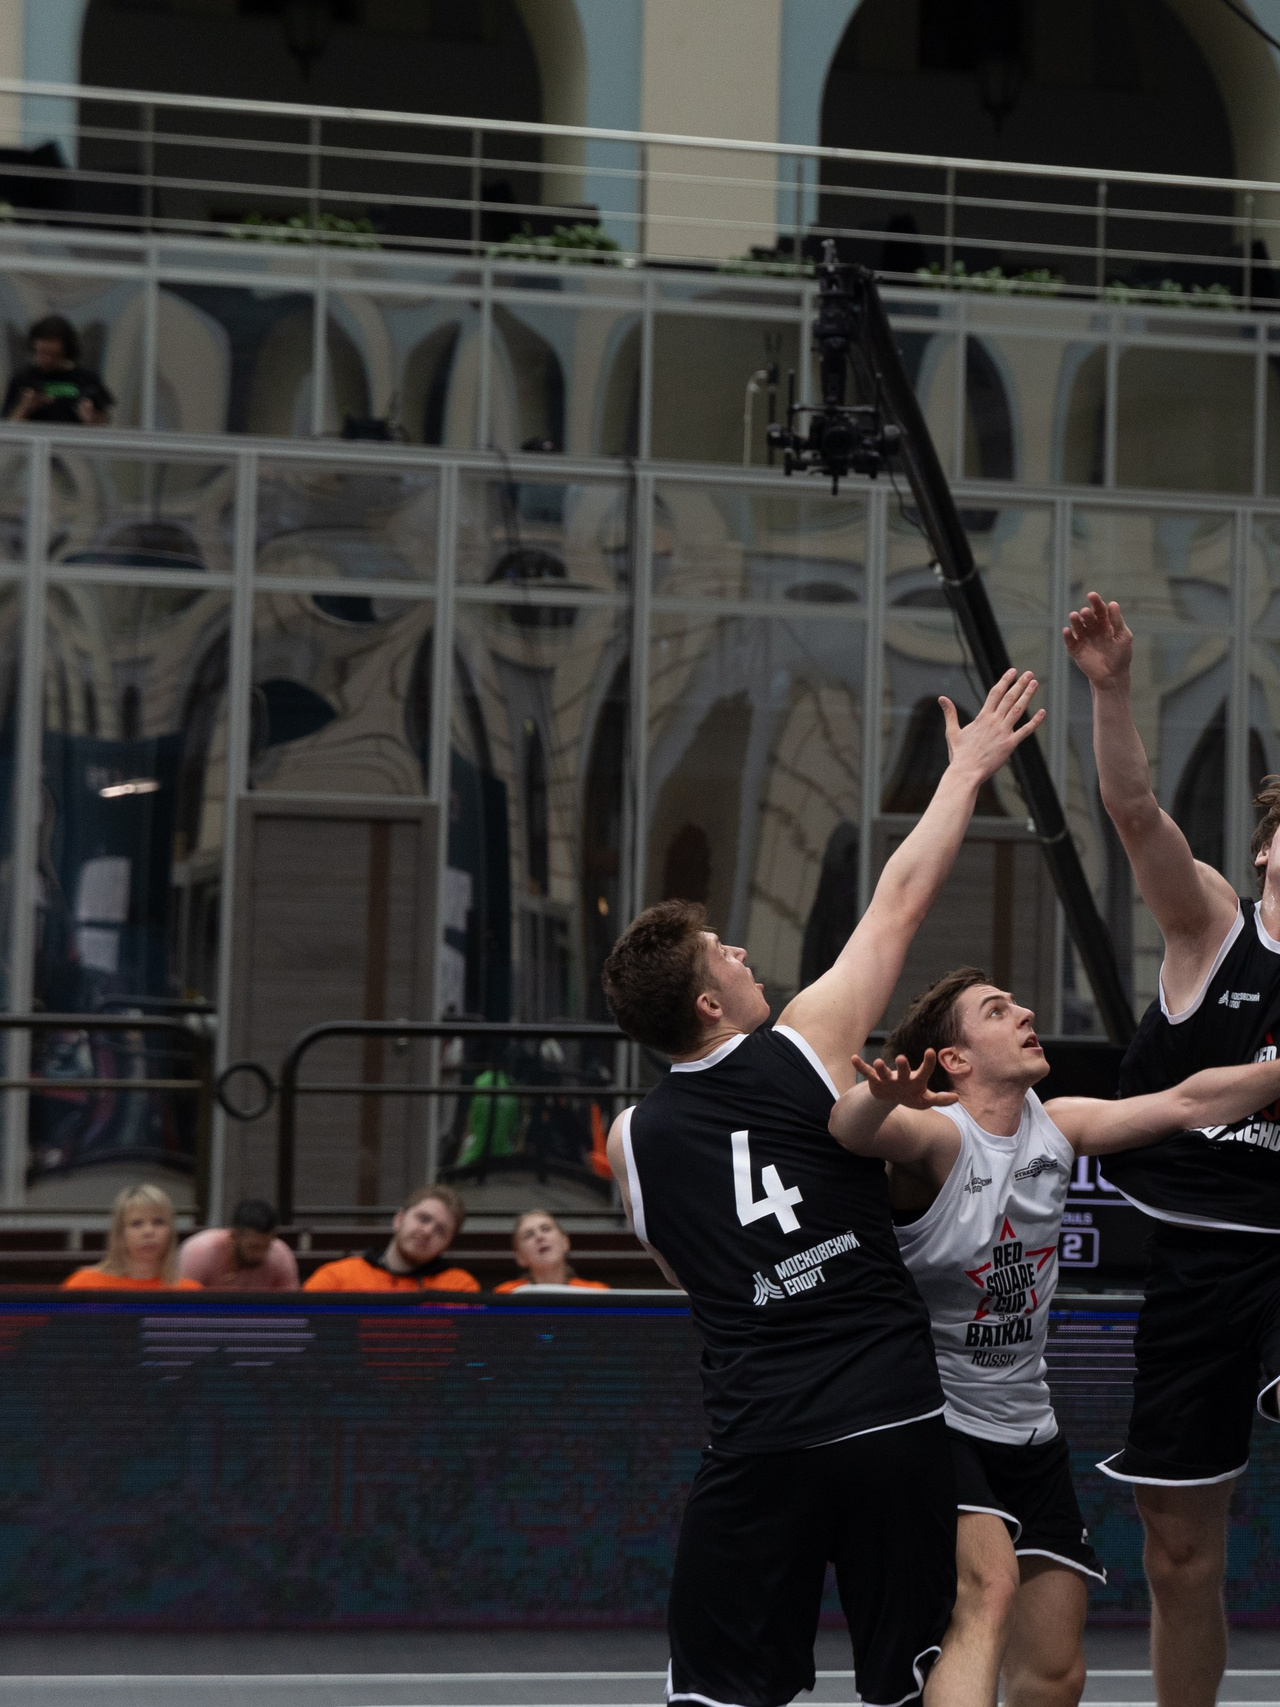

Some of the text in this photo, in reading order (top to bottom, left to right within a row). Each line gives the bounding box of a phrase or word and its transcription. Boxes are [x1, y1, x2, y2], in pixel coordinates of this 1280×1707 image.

[731, 1130, 803, 1234] 4
[1061, 1212, 1093, 1225] OULS
[774, 1230, 861, 1280] МОСКОВСКИЙ
[993, 1241, 1023, 1270] RED
[1062, 1233, 1082, 1260] 2
[783, 1265, 826, 1297] СПОРТ
[986, 1262, 1036, 1297] SQUARE
[993, 1291, 1027, 1314] CUP
[965, 1318, 1034, 1347] BAIKAL
